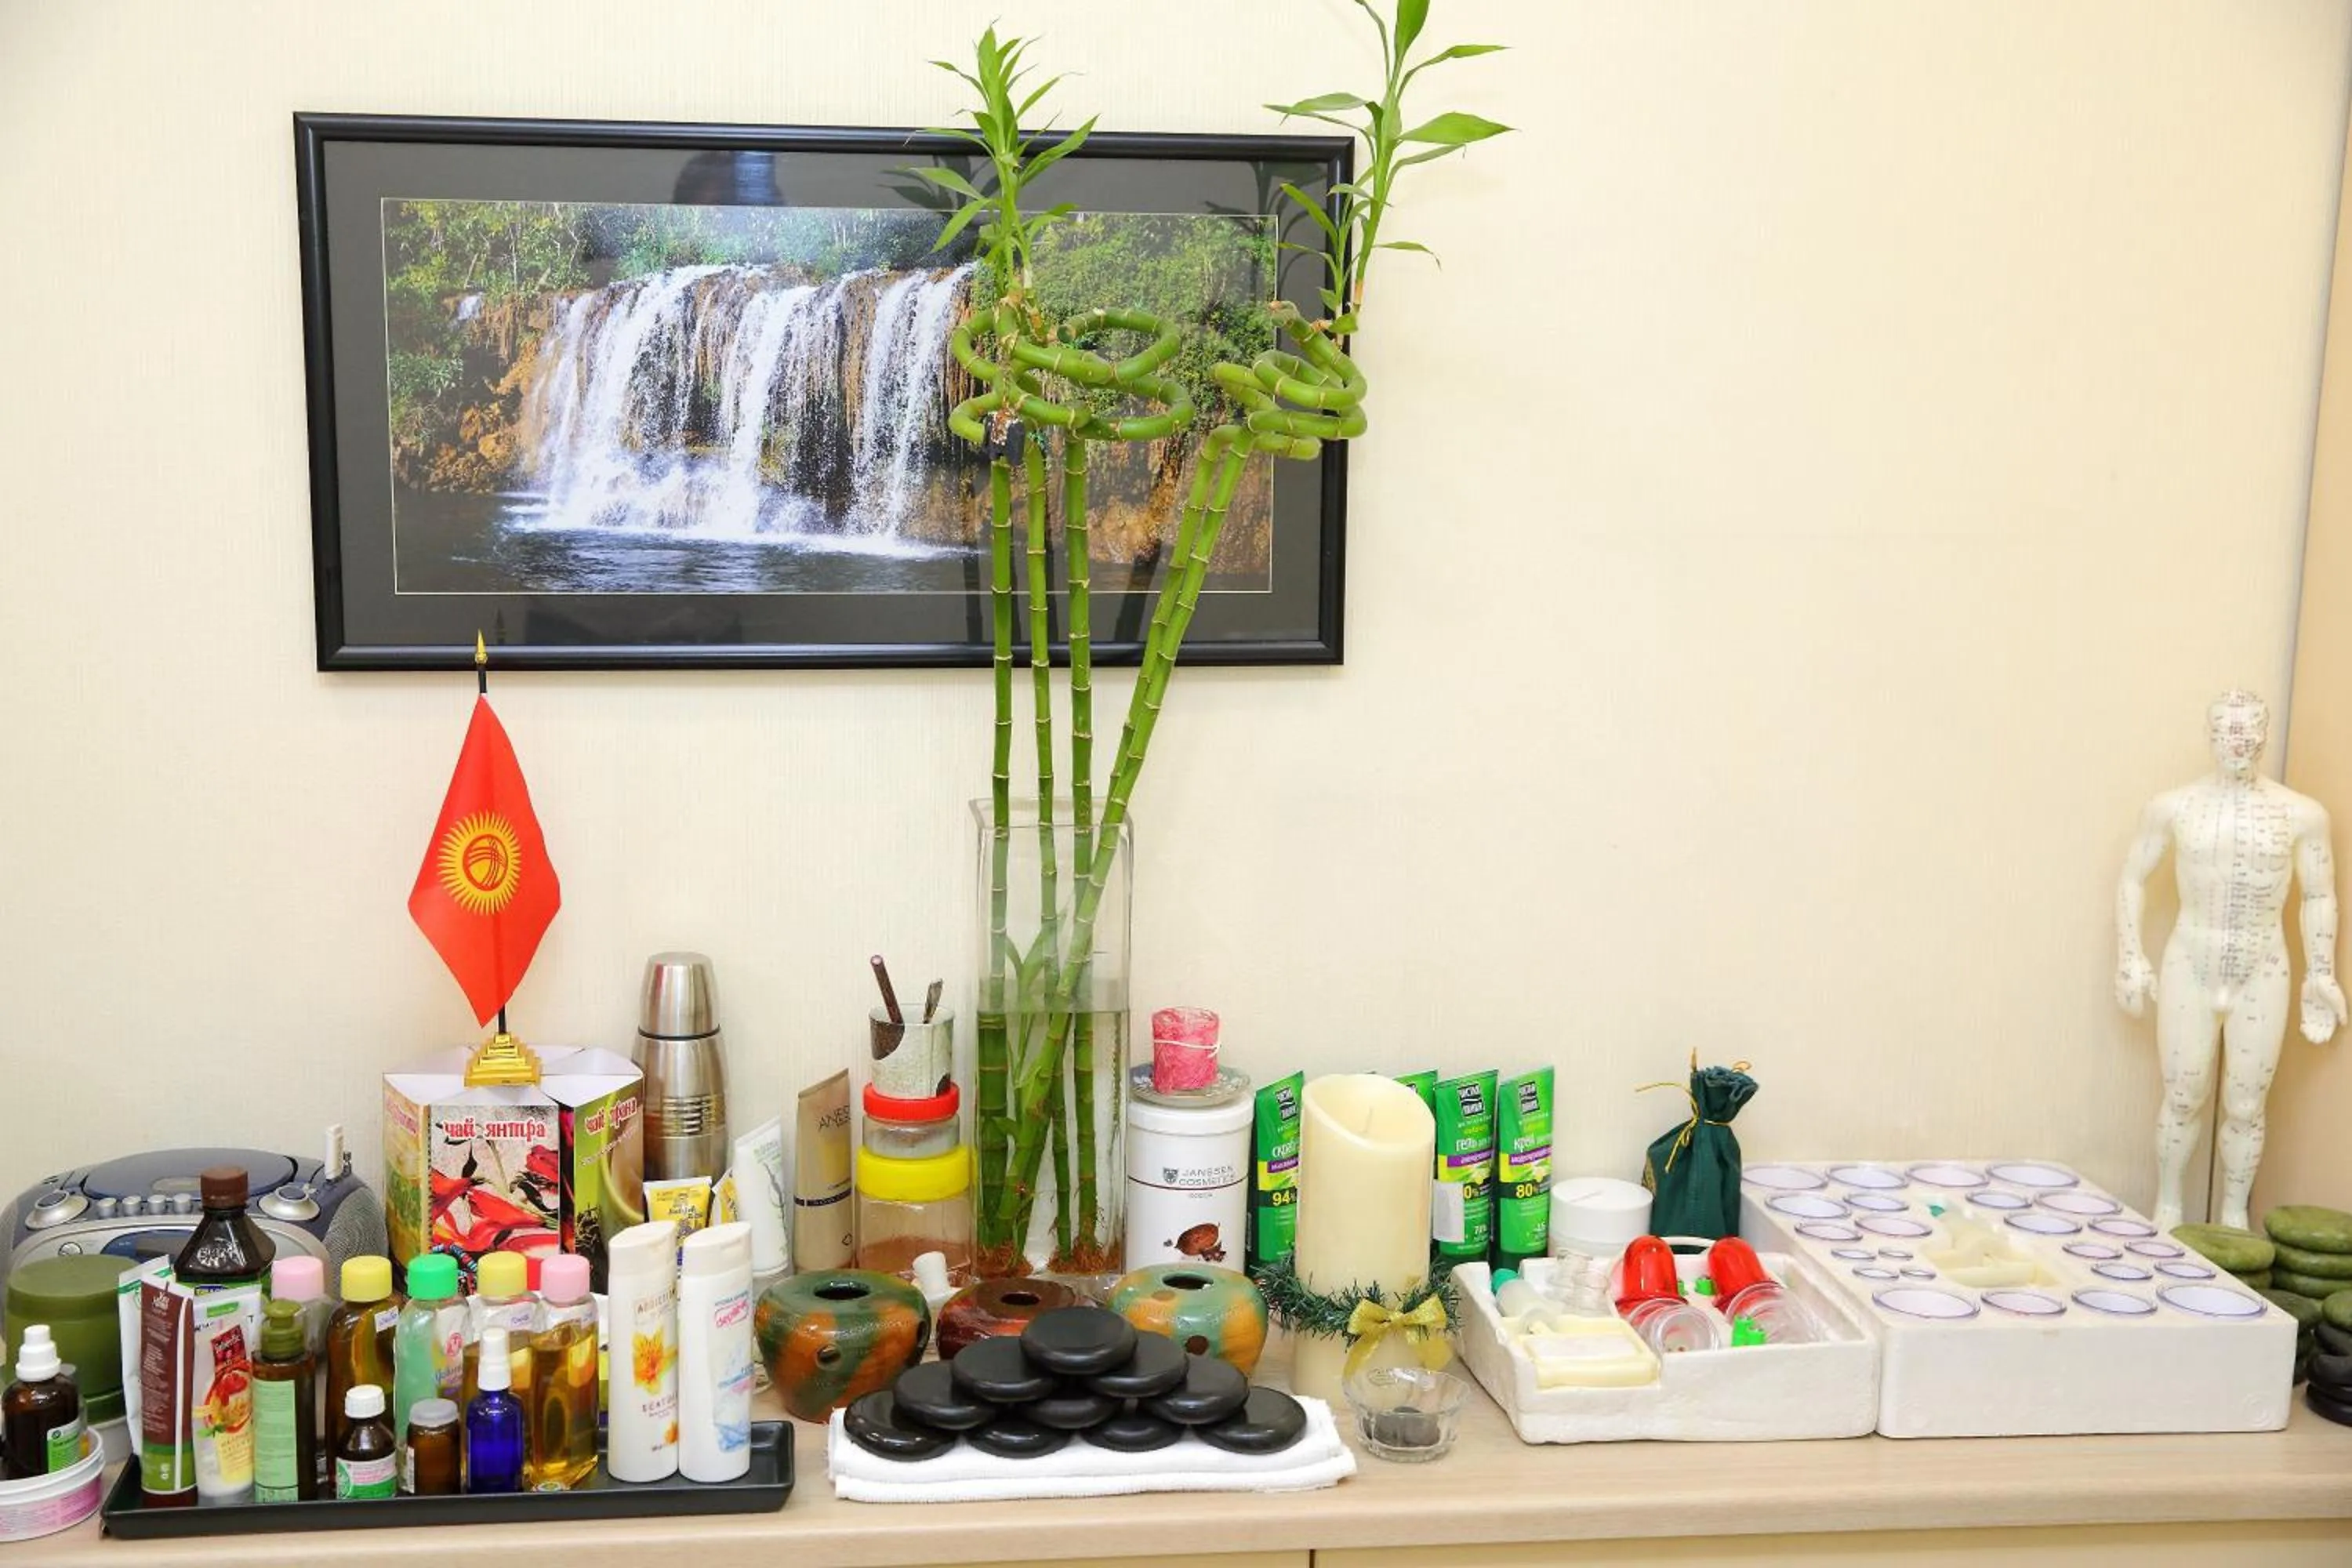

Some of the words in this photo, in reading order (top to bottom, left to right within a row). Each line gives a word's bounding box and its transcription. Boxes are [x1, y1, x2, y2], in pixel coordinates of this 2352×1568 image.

[443, 1118, 475, 1137] чай
[486, 1119, 546, 1142] янтра
[1182, 1166, 1232, 1177] JANSSEN
